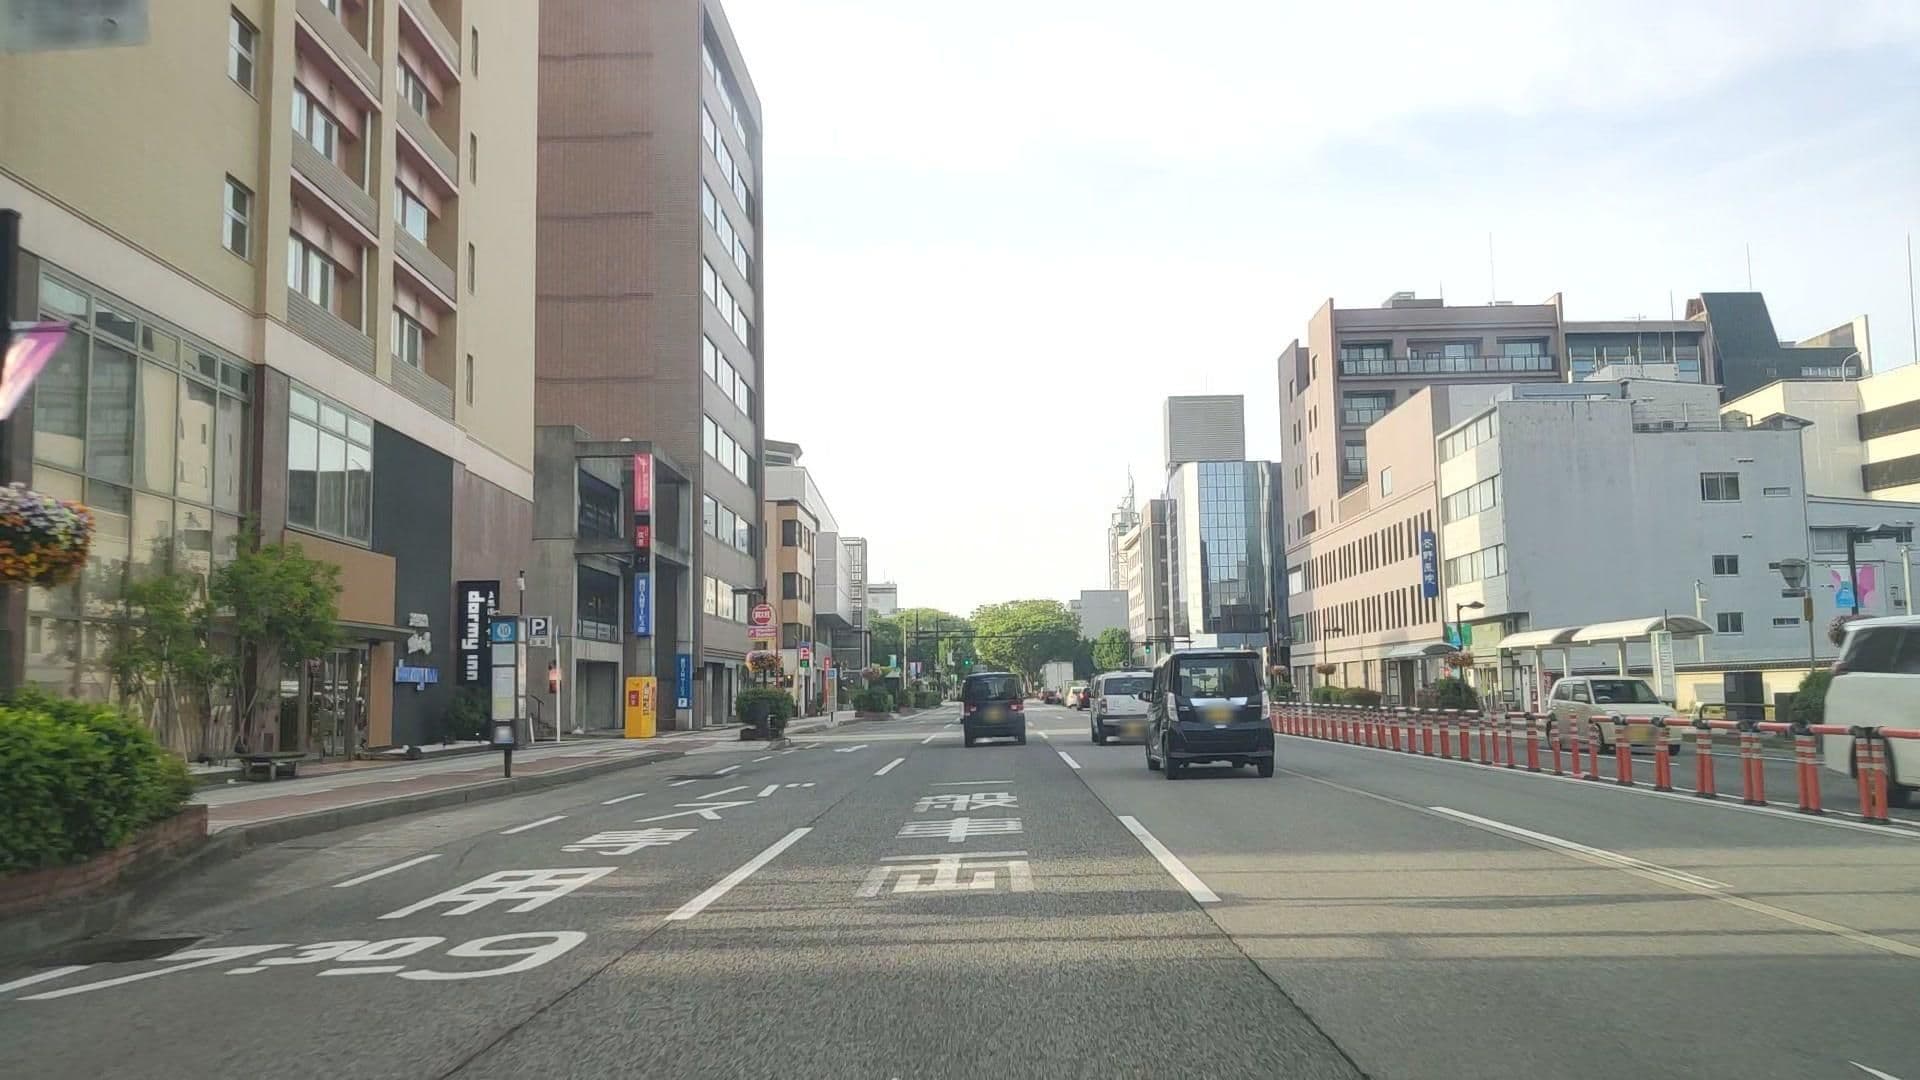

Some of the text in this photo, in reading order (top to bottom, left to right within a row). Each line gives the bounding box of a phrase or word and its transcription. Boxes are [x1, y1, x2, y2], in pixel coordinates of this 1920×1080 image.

[462, 591, 485, 681] dormy inn
[532, 618, 546, 636] P
[856, 780, 1035, 898] 一般車両
